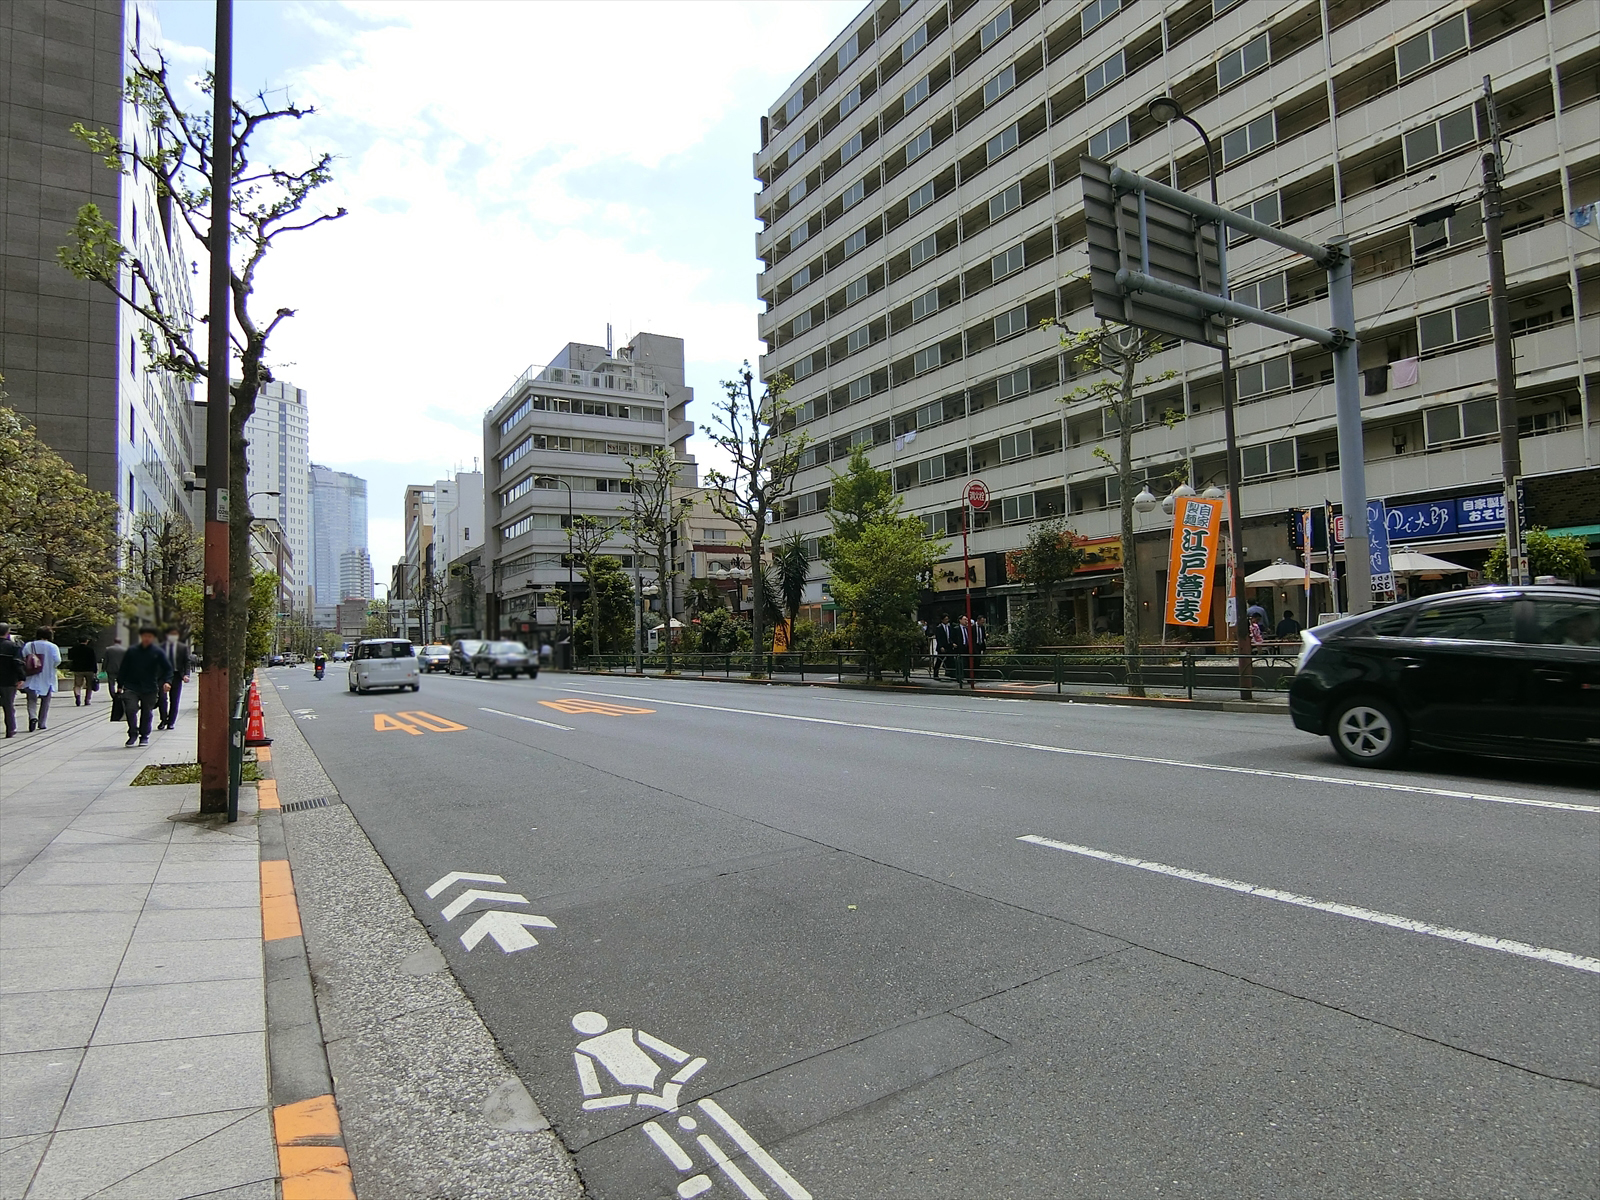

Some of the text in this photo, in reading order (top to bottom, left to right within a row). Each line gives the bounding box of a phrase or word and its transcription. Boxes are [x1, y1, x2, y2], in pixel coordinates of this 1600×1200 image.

[970, 491, 985, 501] 消火栓
[1386, 504, 1449, 533] ゆで太郎
[1174, 528, 1210, 623] 江戸蕎麦
[537, 698, 657, 717] 40
[373, 710, 468, 736] 40
